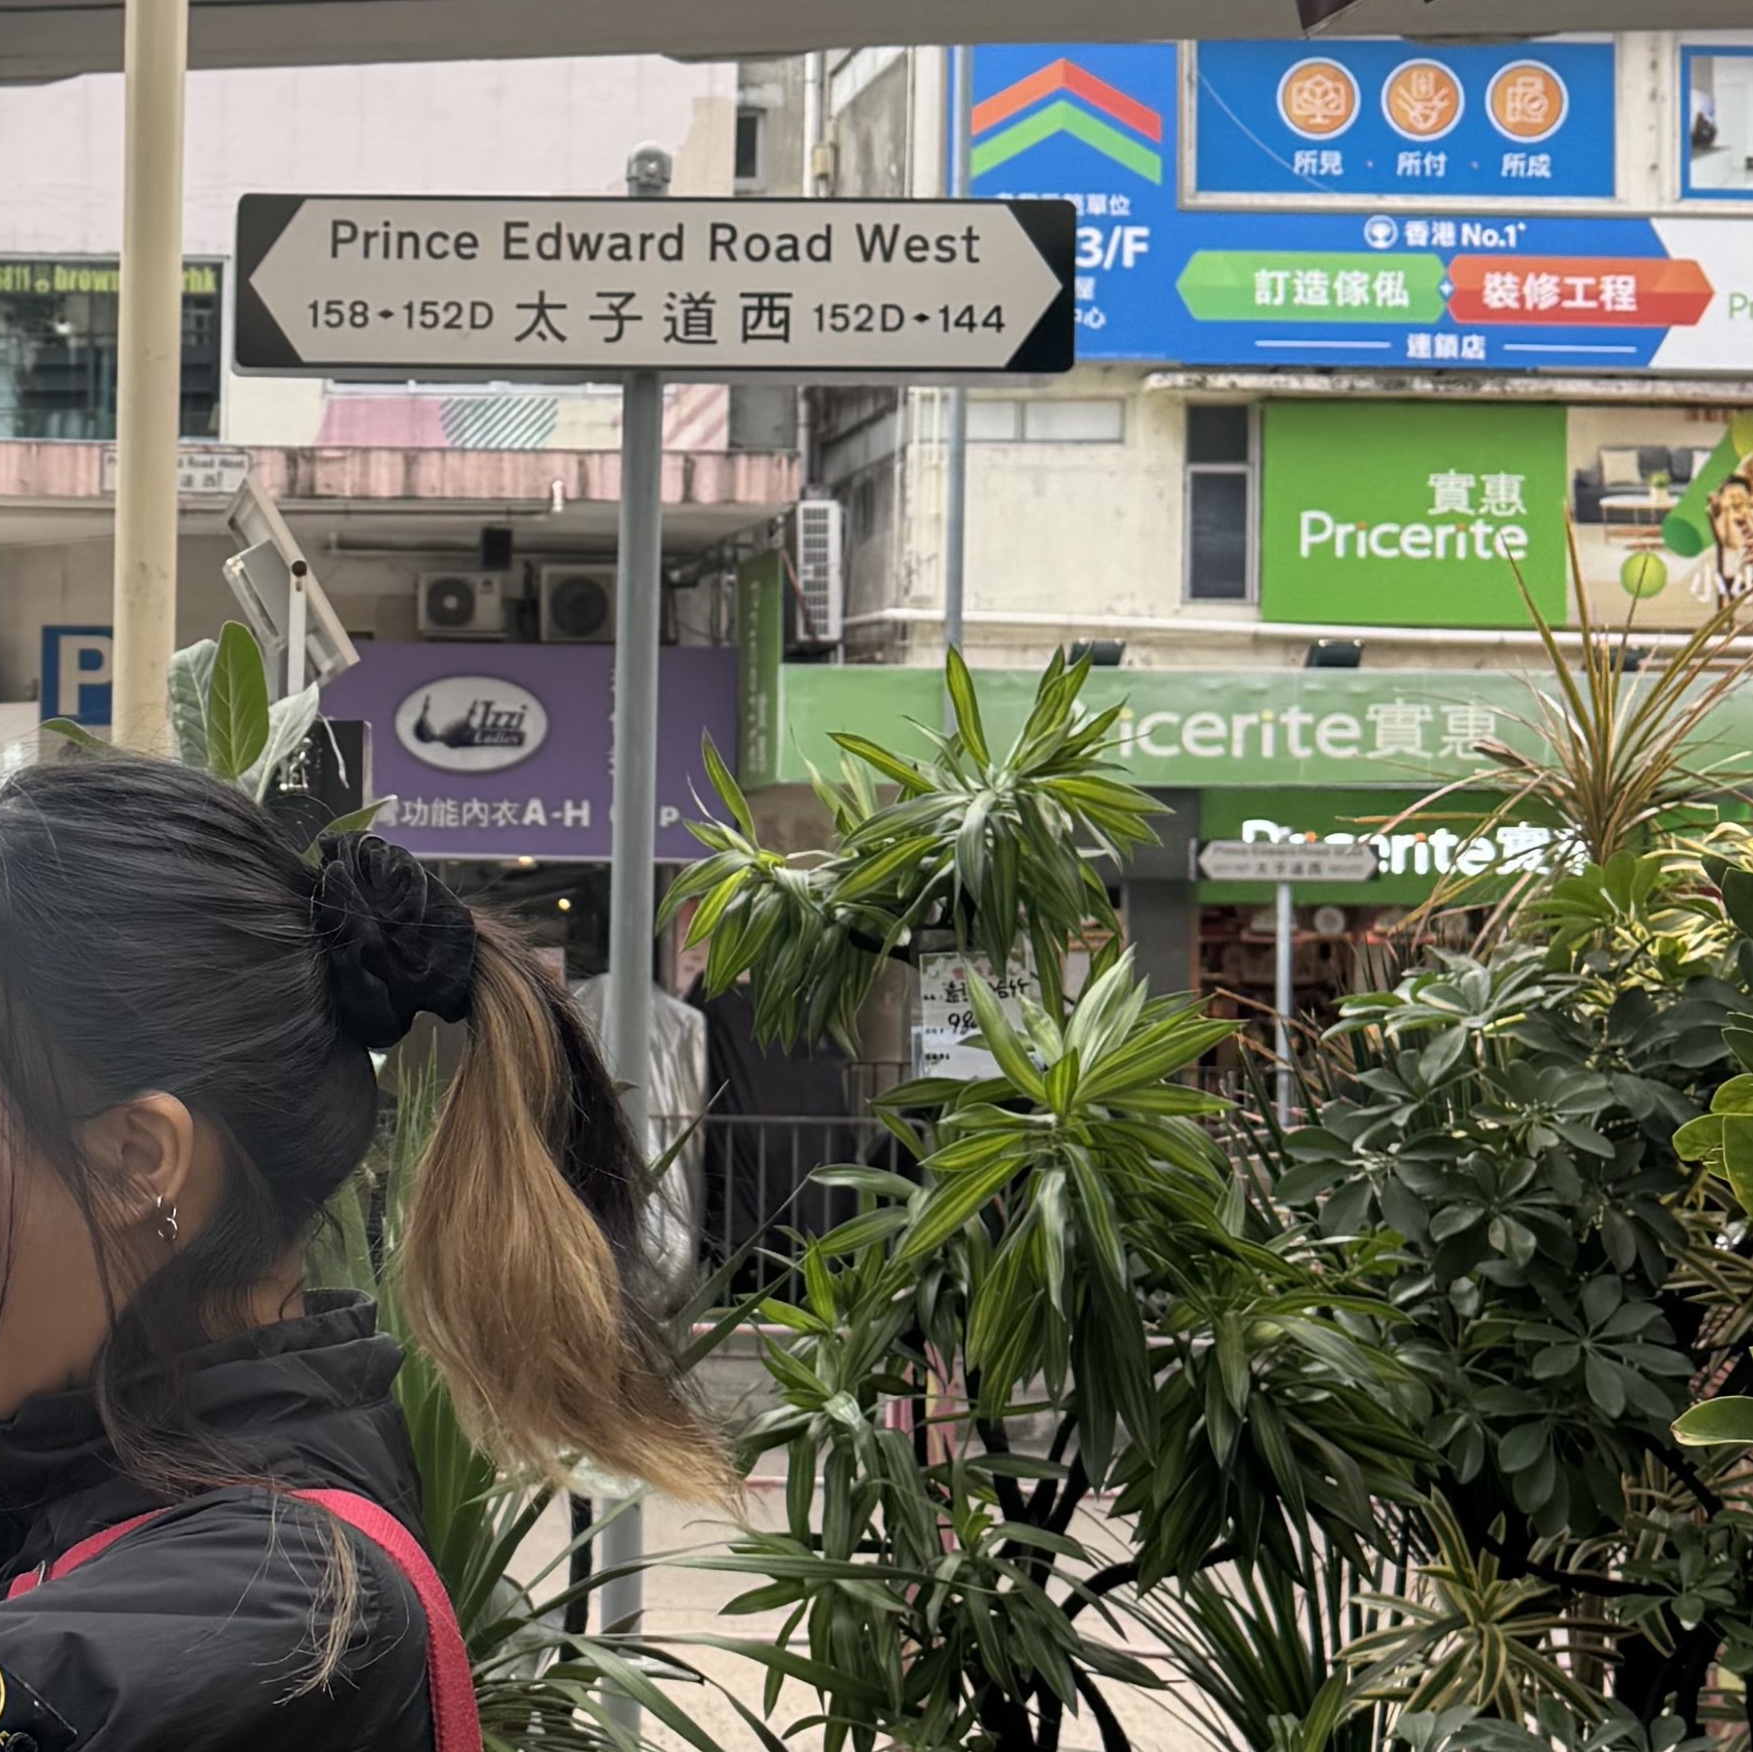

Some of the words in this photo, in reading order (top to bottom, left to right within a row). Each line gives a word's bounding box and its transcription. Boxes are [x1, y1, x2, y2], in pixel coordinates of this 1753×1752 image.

[1292, 150, 1344, 176] 所見
[1397, 150, 1447, 177] 所付
[1501, 153, 1552, 178] 所成
[331, 219, 479, 260] Prince
[503, 221, 684, 261] Edward
[709, 222, 833, 263] Road
[855, 223, 981, 263] West
[1404, 220, 1456, 246] 香港
[1483, 271, 1639, 312] 裝修工程
[307, 301, 369, 329] 158
[401, 301, 494, 330] 152D
[514, 290, 793, 344] 太子道西
[813, 303, 904, 333] 152D
[938, 304, 1006, 333] 144
[1427, 468, 1528, 517] 實惠
[1300, 510, 1529, 560] Pricerite
[57, 634, 114, 716] P
[1070, 700, 1362, 759] icerite
[522, 797, 591, 828] A-H
